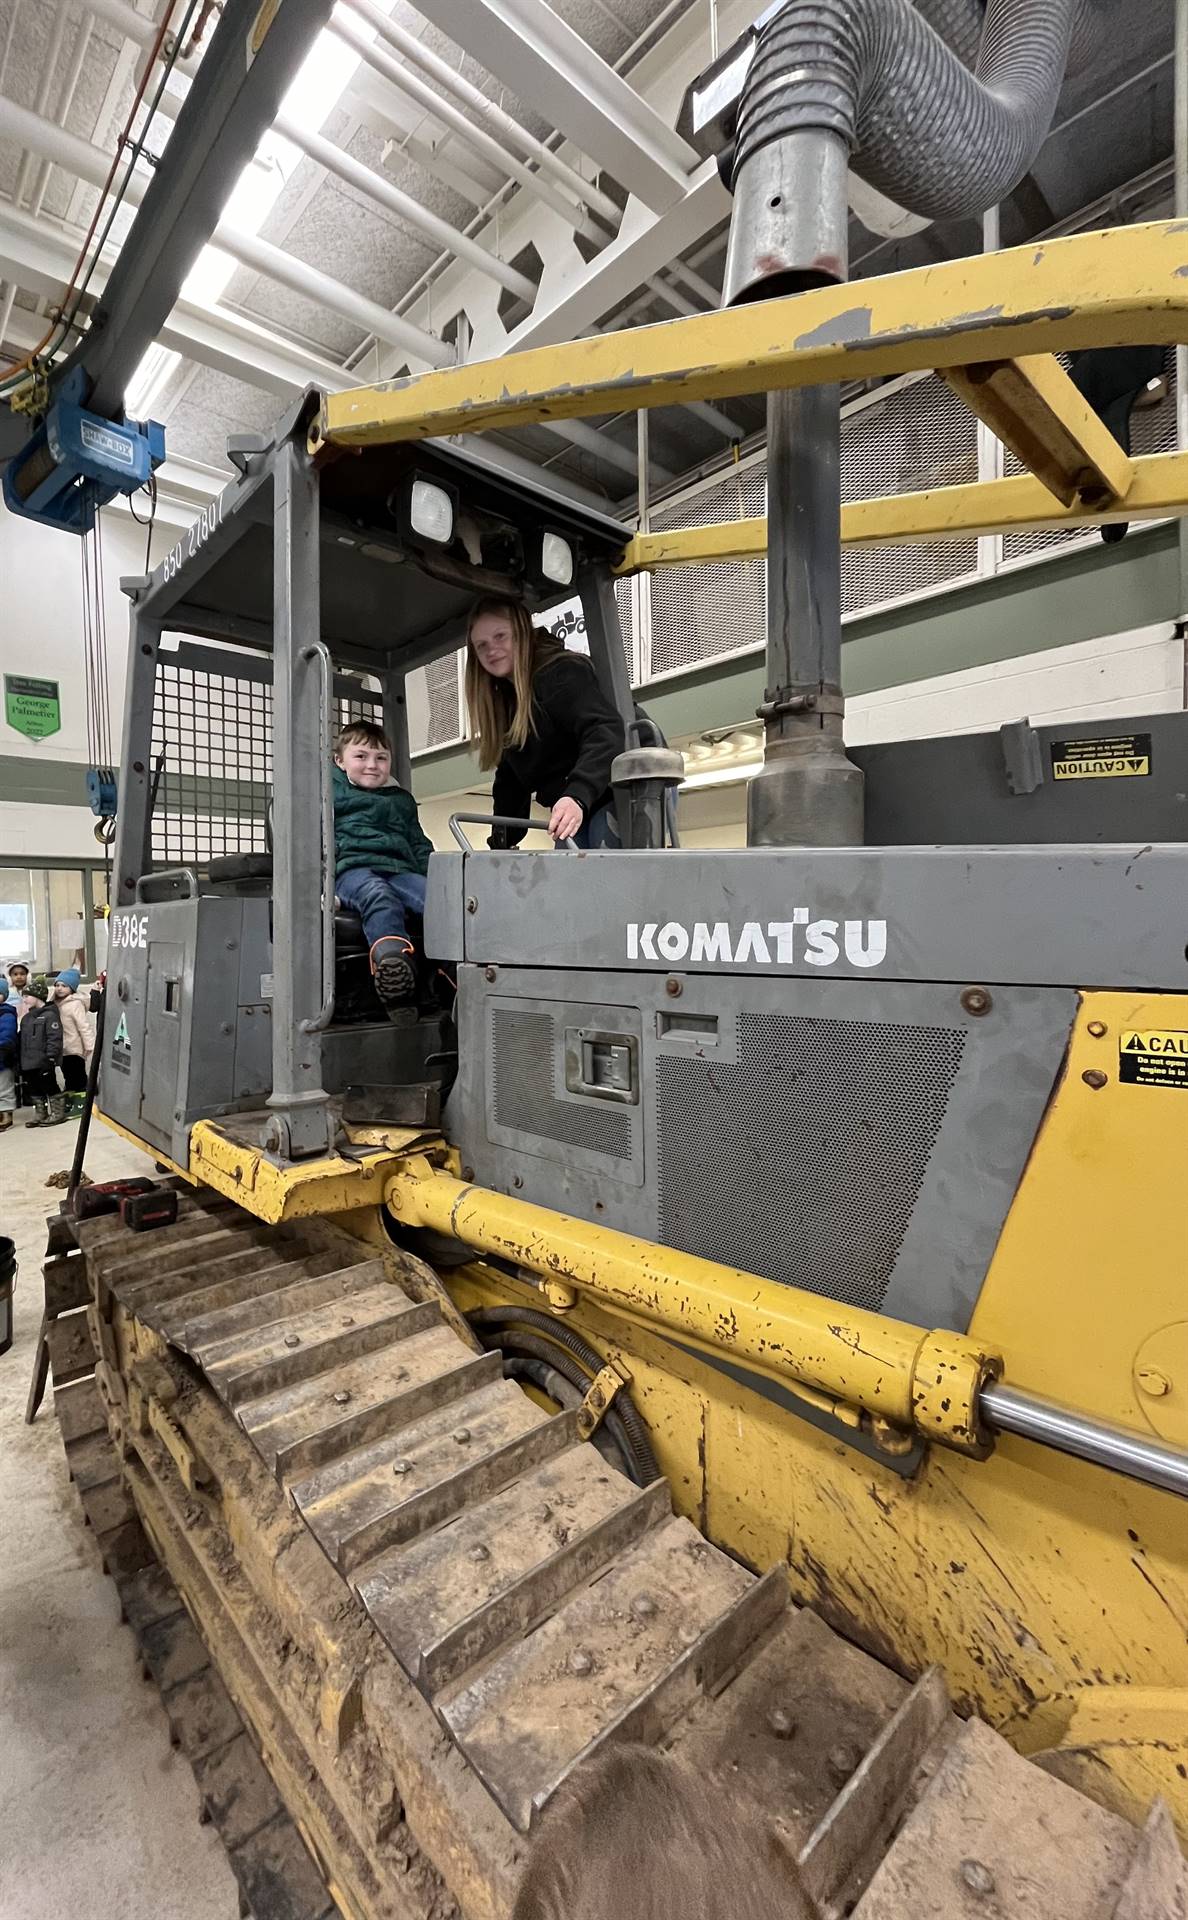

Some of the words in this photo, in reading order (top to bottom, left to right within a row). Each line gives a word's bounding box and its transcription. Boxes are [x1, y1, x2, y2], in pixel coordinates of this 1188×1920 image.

[163, 541, 182, 583] 850
[16, 696, 50, 709] George
[1056, 760, 1126, 775] CAUTION
[112, 914, 149, 949] D38E
[626, 907, 888, 968] KOMATSU
[1137, 1056, 1149, 1064] Do
[1139, 1066, 1167, 1075] engine
[1168, 1067, 1176, 1075] is
[1177, 1068, 1186, 1076] in
